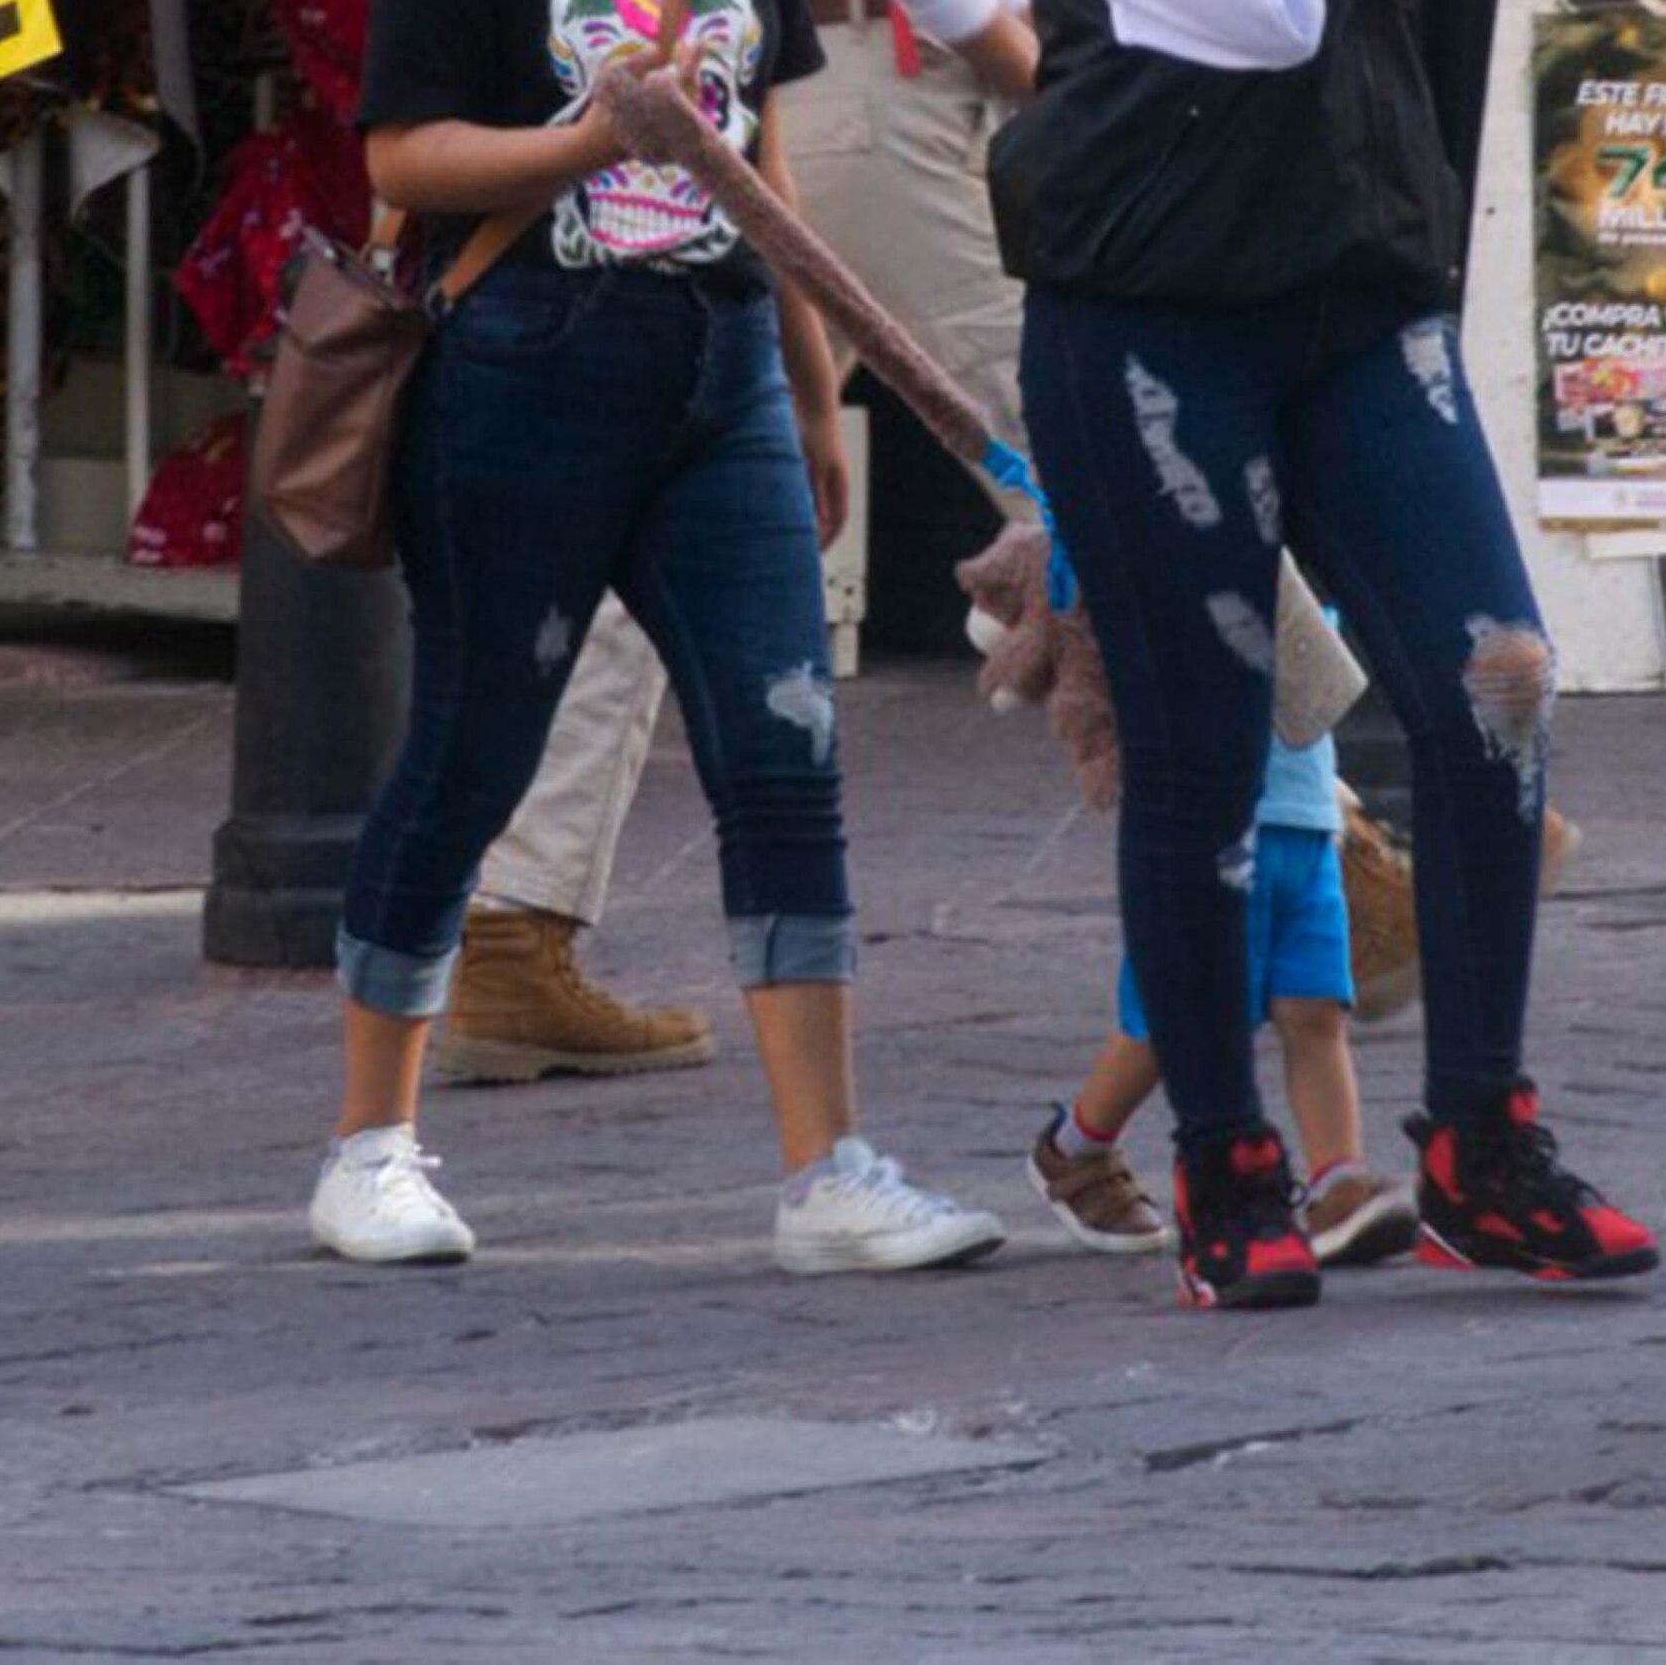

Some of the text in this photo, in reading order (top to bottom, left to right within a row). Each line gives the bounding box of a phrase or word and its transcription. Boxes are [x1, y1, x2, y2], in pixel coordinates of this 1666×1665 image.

[1574, 79, 1638, 107] ESTE
[1604, 112, 1660, 136] HAY
[1547, 333, 1581, 357] TU
